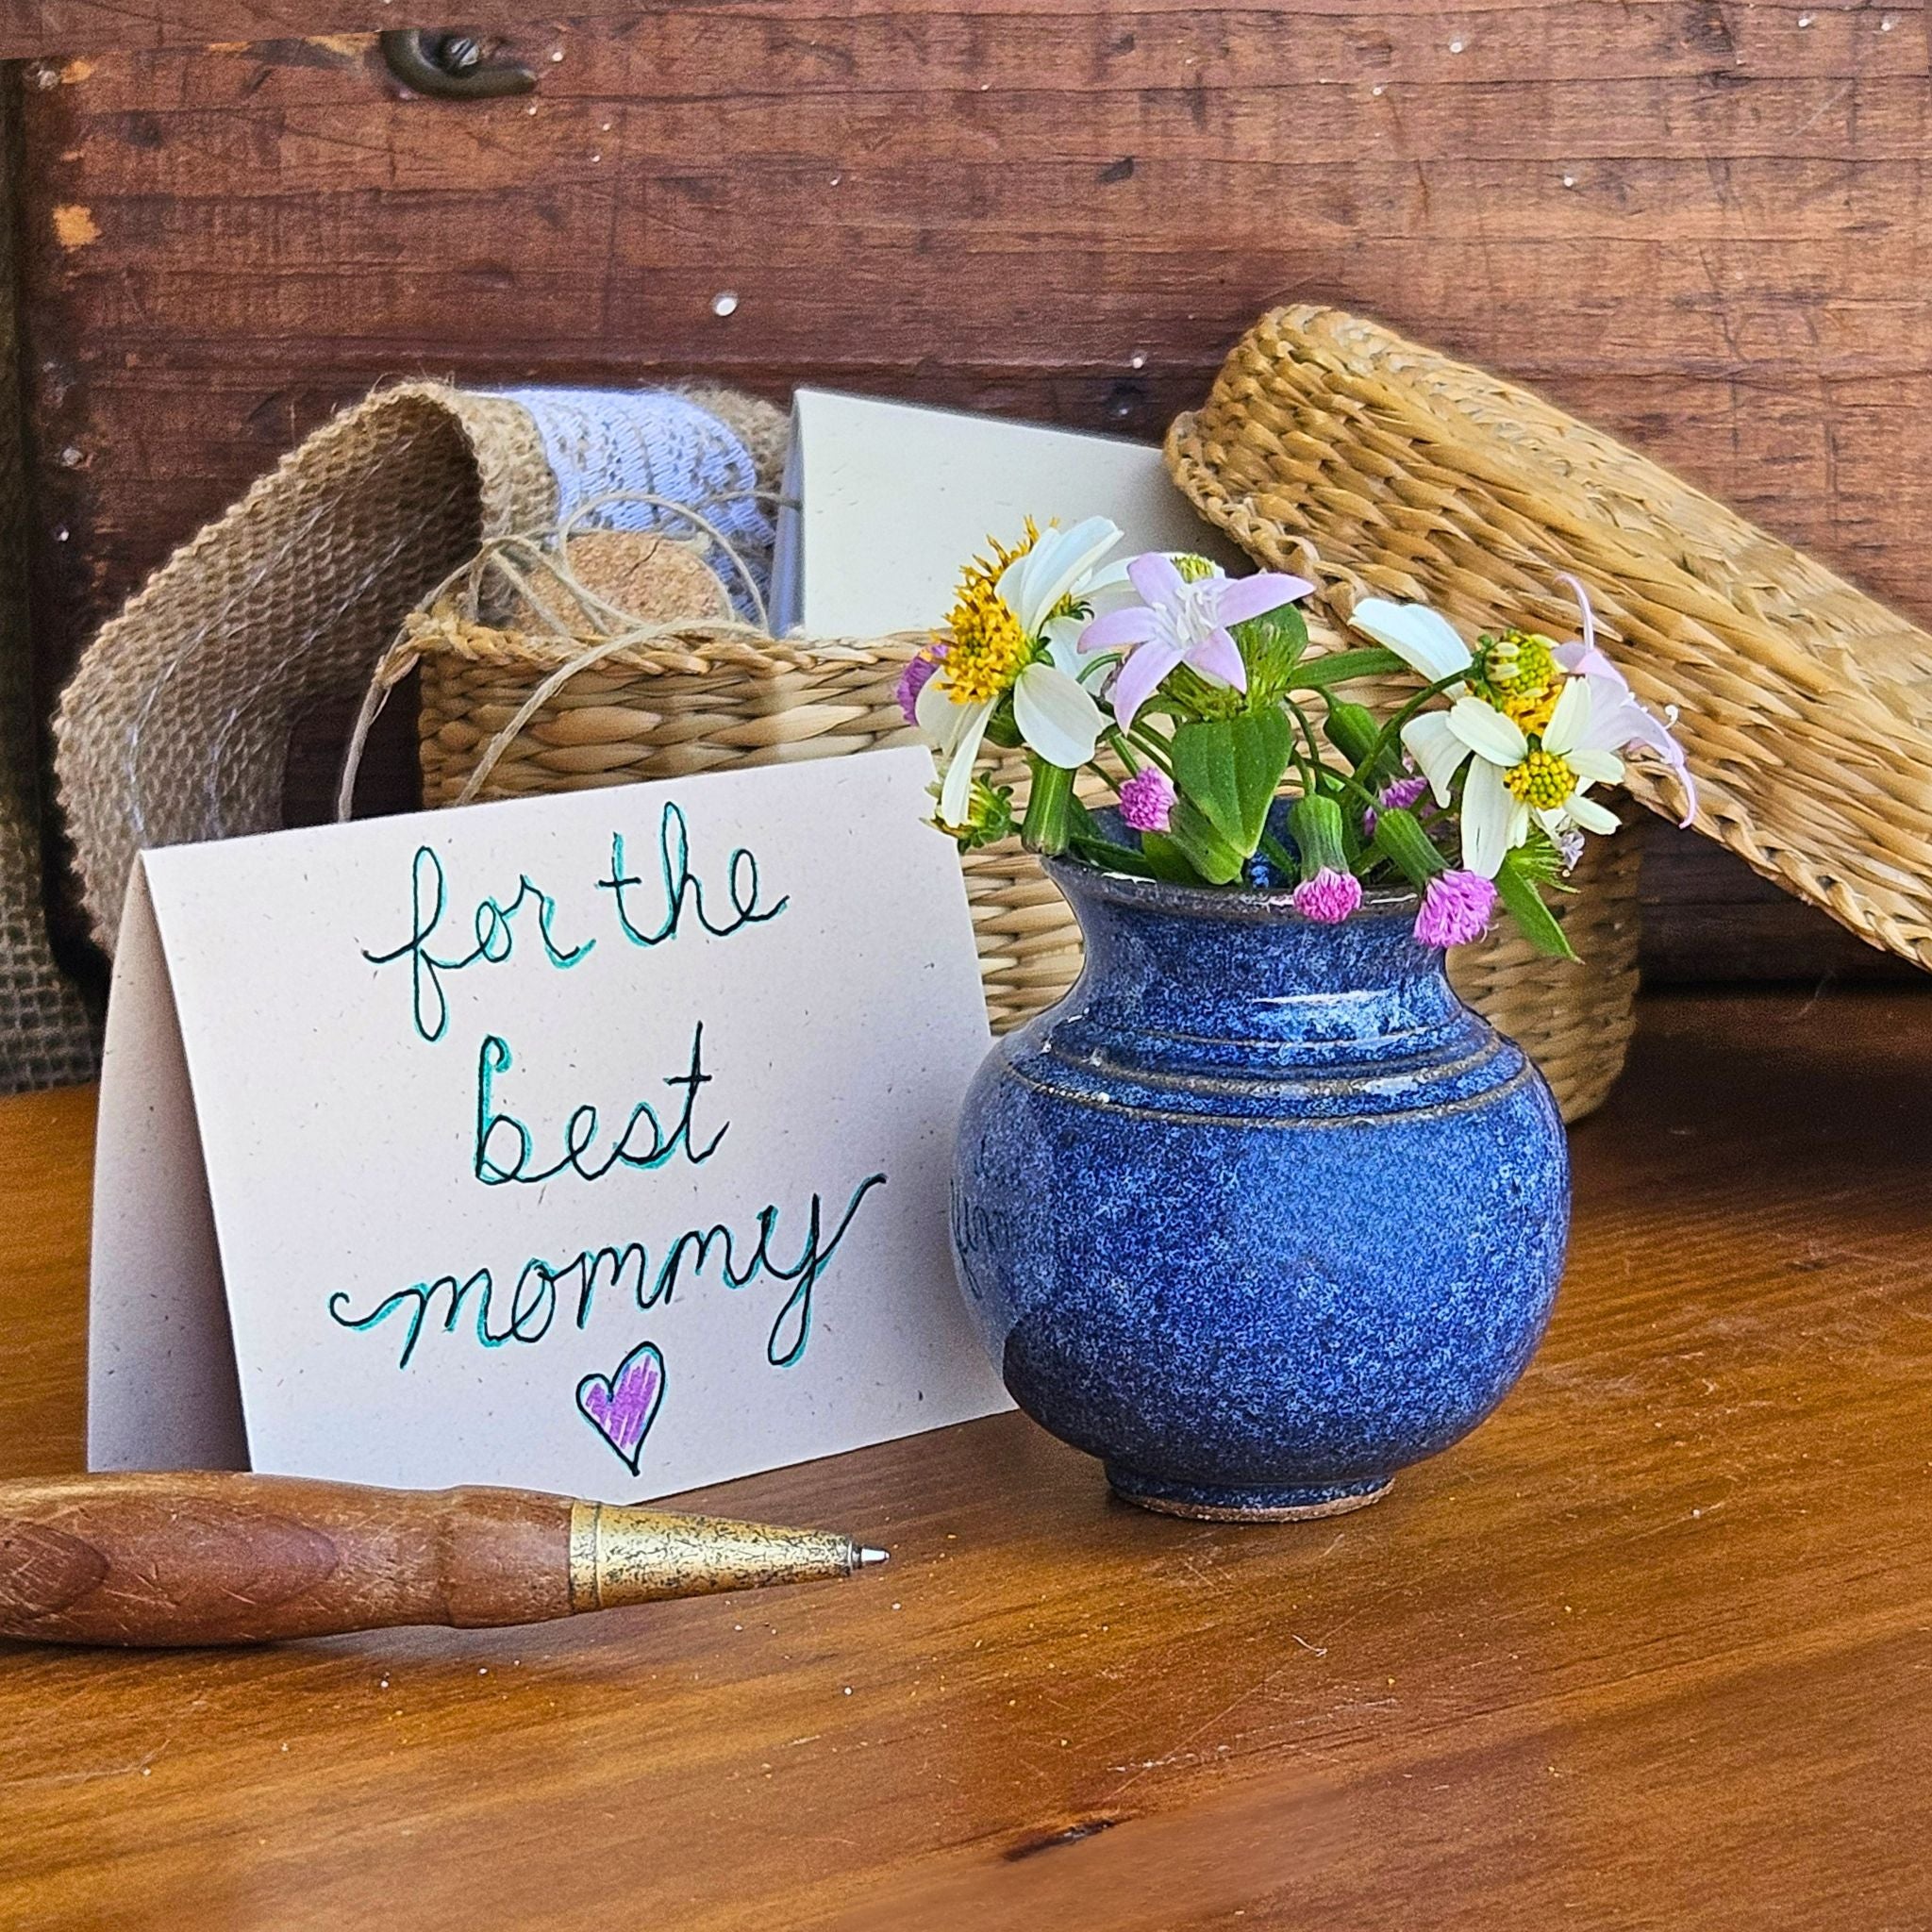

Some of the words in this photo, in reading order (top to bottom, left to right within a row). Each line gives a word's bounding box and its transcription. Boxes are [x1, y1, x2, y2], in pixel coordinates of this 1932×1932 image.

[362, 844, 595, 1041] for
[597, 802, 791, 946] the
[475, 1020, 730, 1185] best
[329, 1173, 888, 1369] mommy
